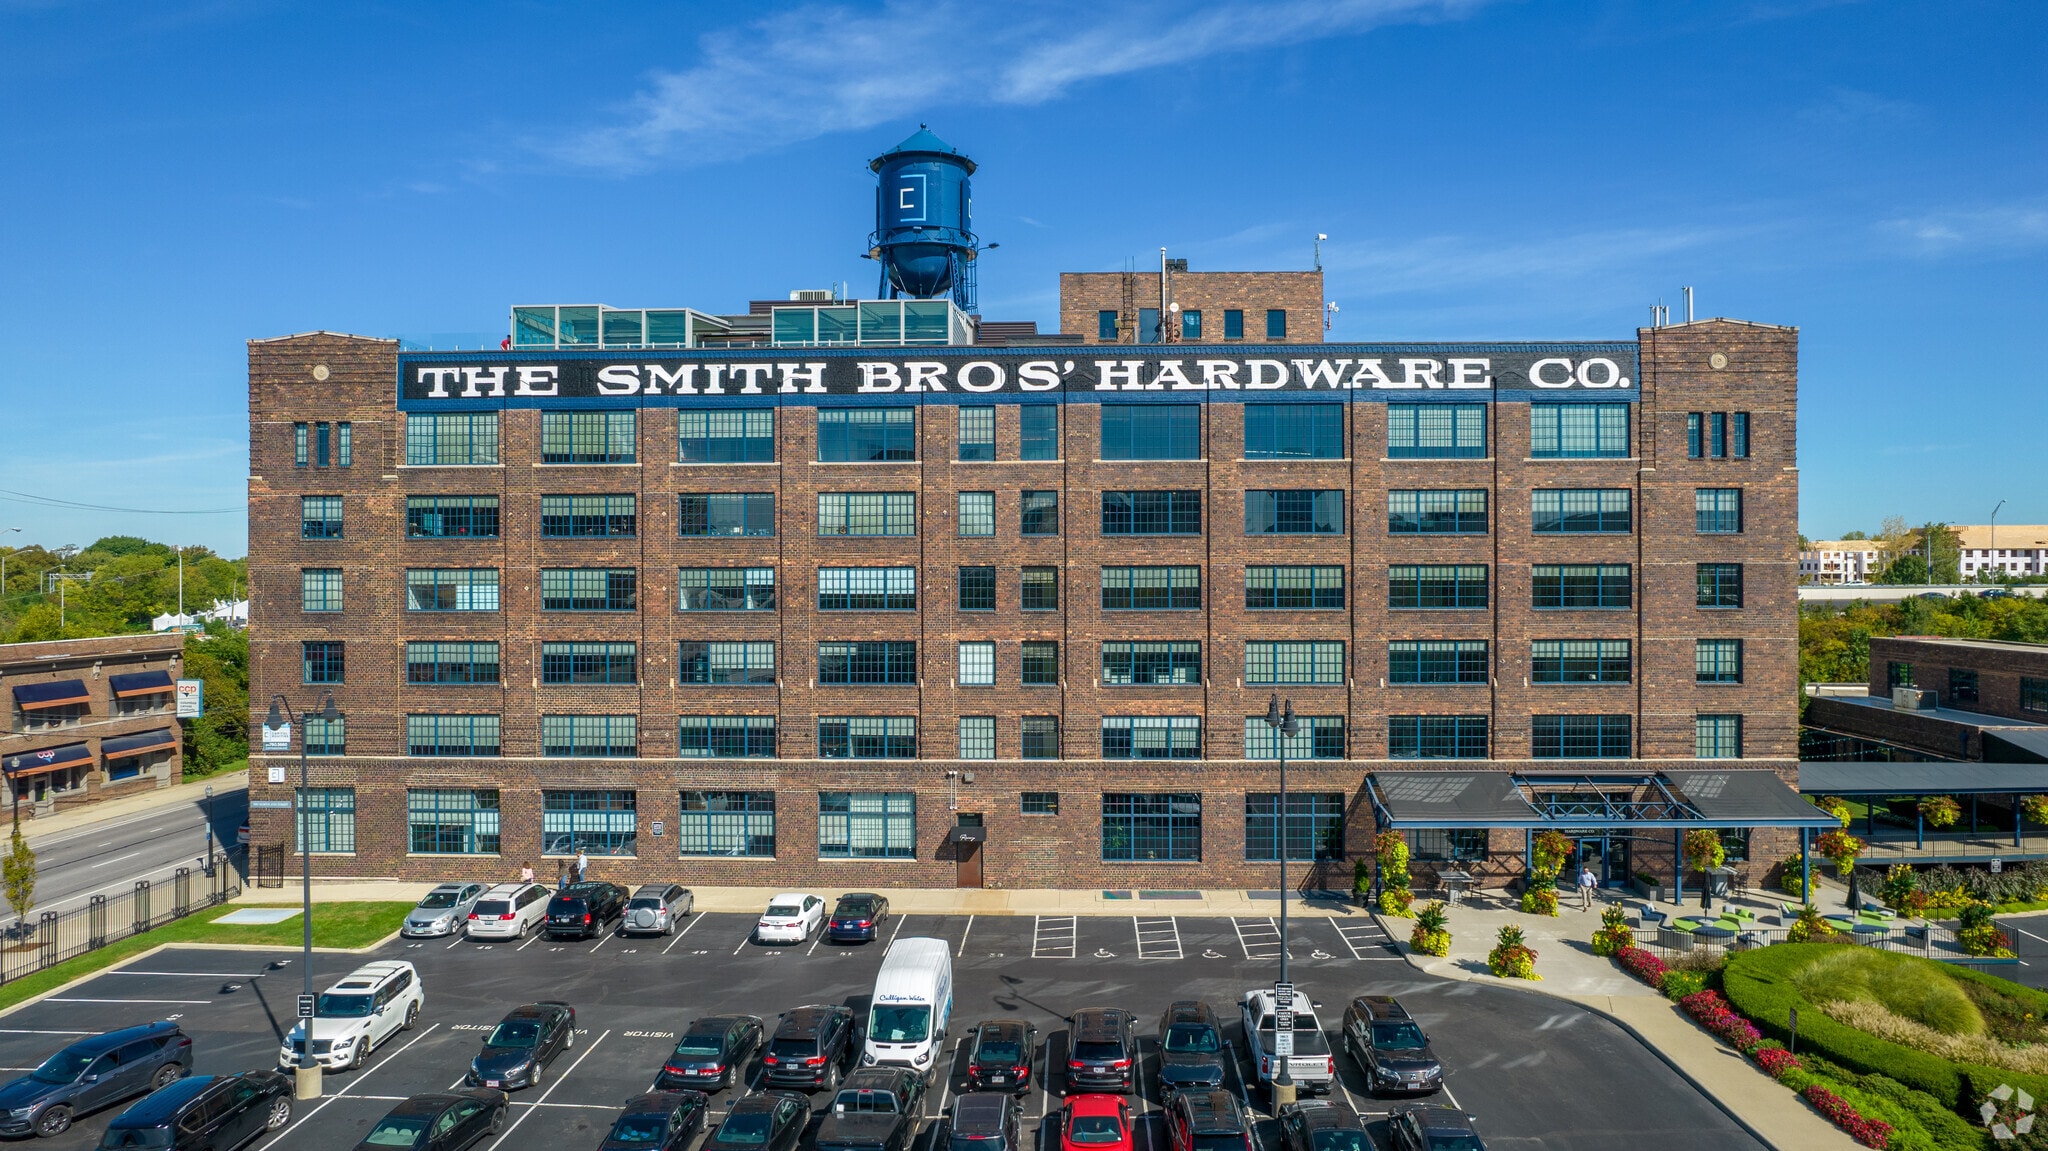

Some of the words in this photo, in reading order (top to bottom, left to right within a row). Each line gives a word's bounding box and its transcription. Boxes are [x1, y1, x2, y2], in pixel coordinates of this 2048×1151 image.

[417, 366, 559, 397] THE
[597, 363, 828, 395] SMITH
[857, 360, 1074, 393] BROS'
[1095, 357, 1492, 391] HARDWARE
[1529, 357, 1631, 389] CO.
[179, 685, 196, 694] ccp
[36, 749, 55, 759] ccp
[879, 994, 908, 1003] Culligan
[623, 1030, 675, 1038] VISITOR
